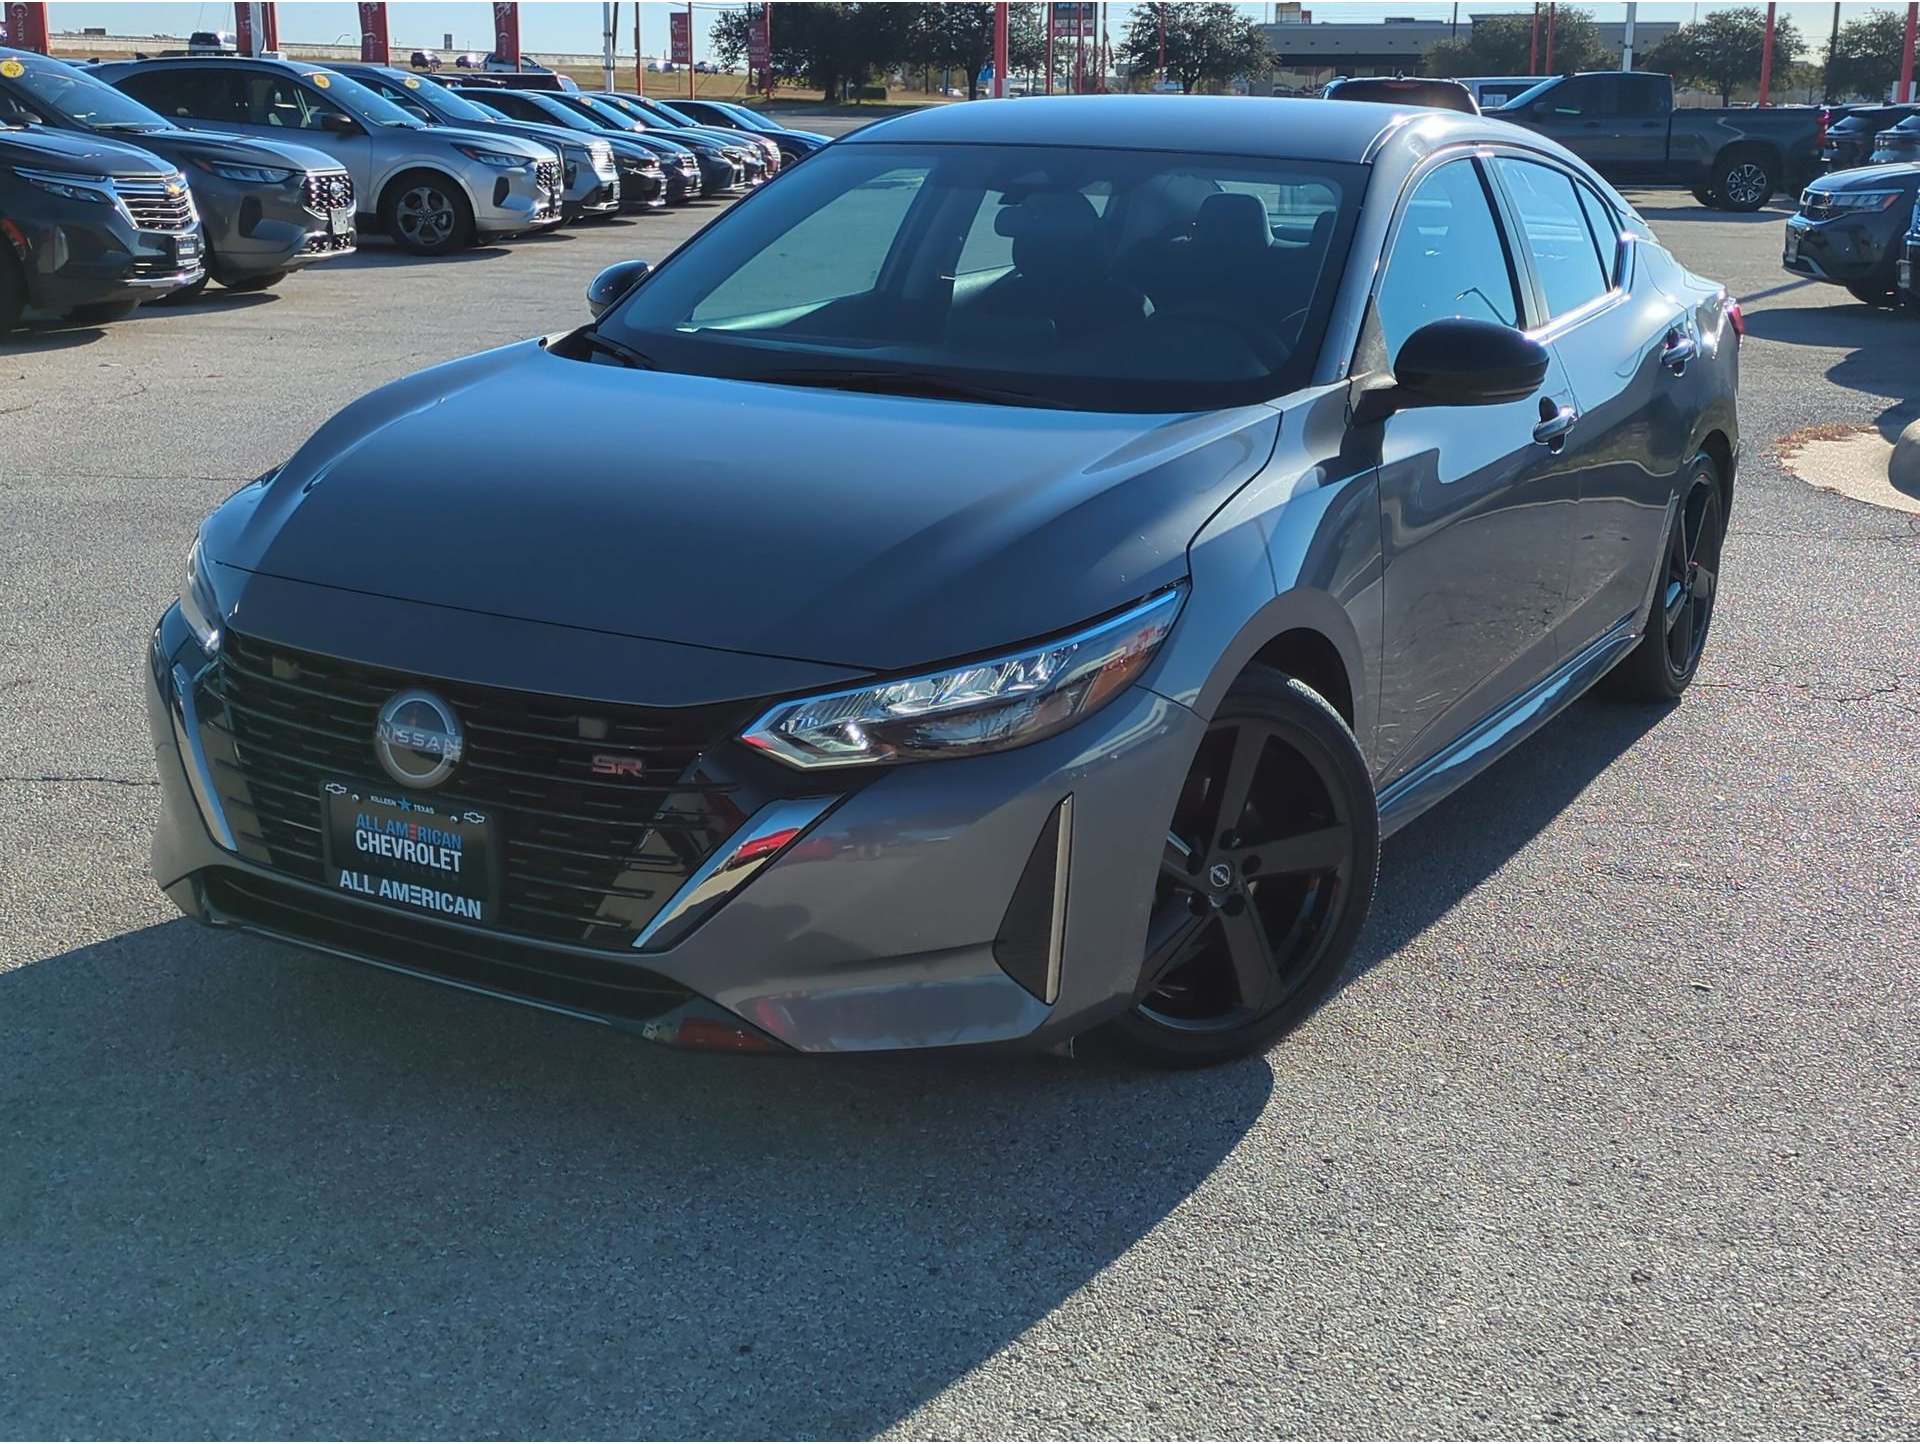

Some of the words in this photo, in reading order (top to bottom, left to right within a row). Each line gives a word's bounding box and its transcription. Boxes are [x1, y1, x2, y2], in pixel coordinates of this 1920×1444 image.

[377, 723, 460, 755] NISSAN
[592, 755, 642, 778] SR
[370, 795, 397, 807] KILLEEN
[413, 804, 435, 815] TEXAS
[356, 813, 383, 833] ALL
[386, 819, 464, 849] AMERICAN
[355, 829, 462, 873] CHEVROLET
[339, 870, 375, 895] ALL
[379, 878, 481, 920] AMERICAN
